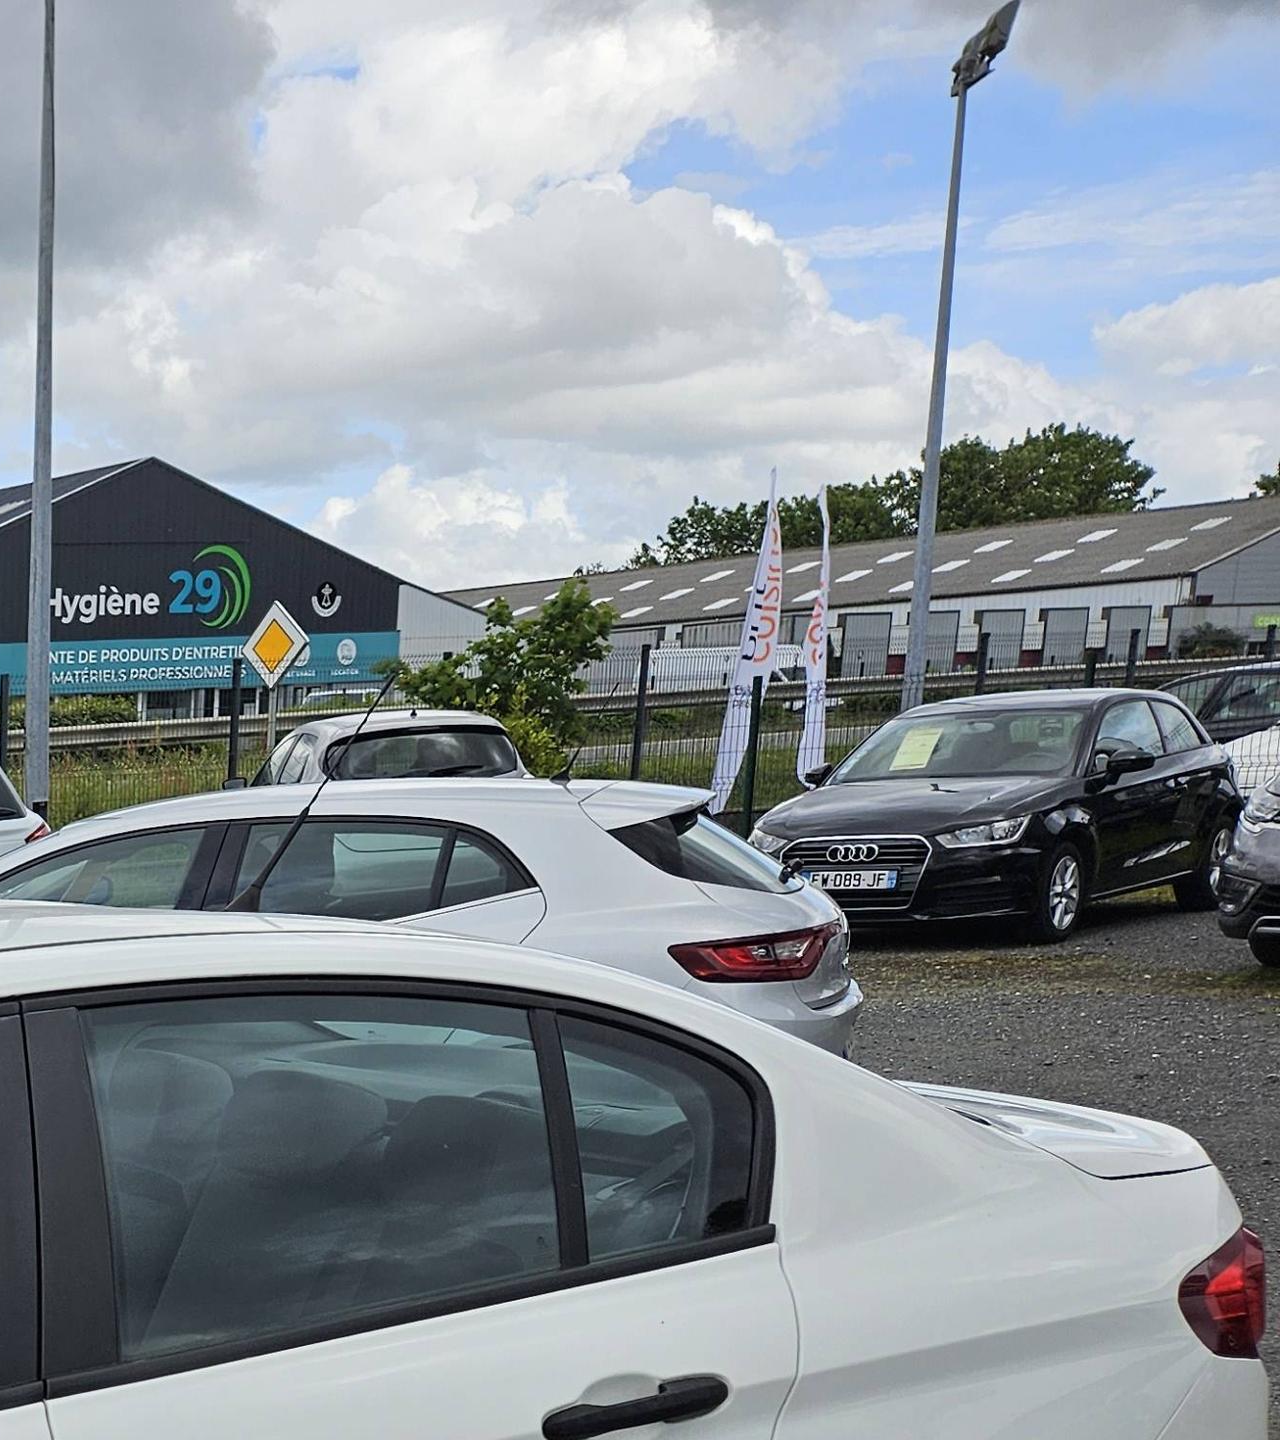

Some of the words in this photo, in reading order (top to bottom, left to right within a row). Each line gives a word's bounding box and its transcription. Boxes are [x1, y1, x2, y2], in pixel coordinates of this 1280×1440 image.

[168, 570, 221, 614] 29
[78, 650, 97, 663] DE
[101, 647, 169, 662] PRODUITS
[52, 666, 126, 685] MATÉRIELS
[130, 664, 247, 682] PROFESSIONNES
